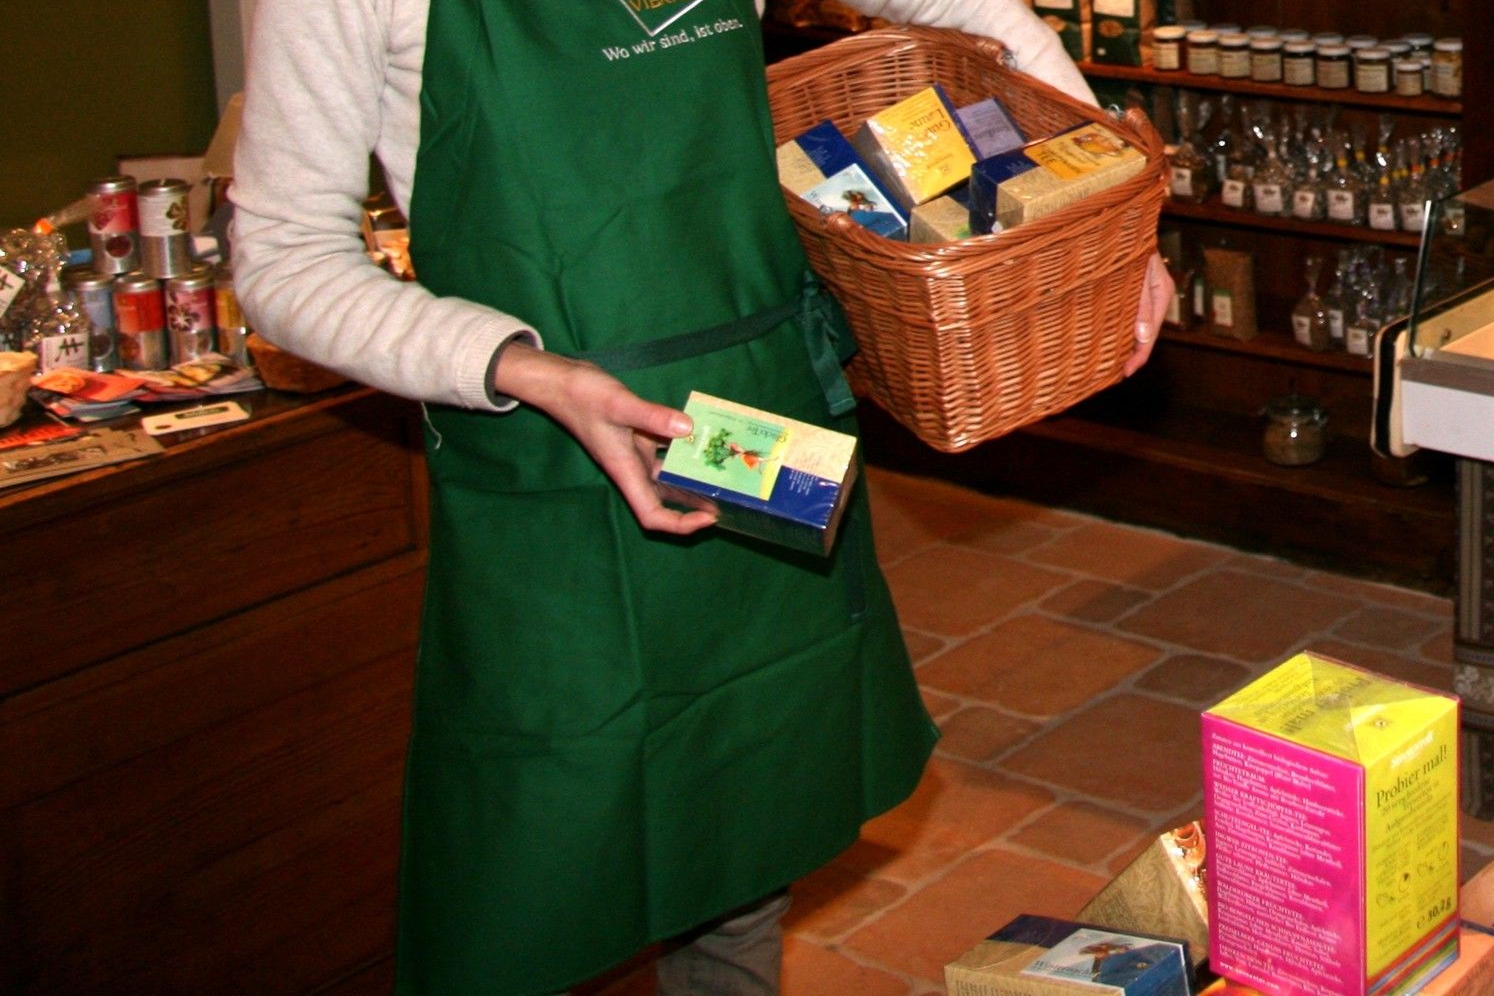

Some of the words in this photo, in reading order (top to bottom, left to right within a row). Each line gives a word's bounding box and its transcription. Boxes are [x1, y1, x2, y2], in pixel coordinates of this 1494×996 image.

[602, 47, 630, 62] Wo
[631, 39, 657, 56] wir
[658, 30, 696, 50] sind,
[693, 24, 714, 40] ist
[714, 18, 744, 35] oben.
[1375, 768, 1420, 808] Probier
[1422, 744, 1448, 775] mal!
